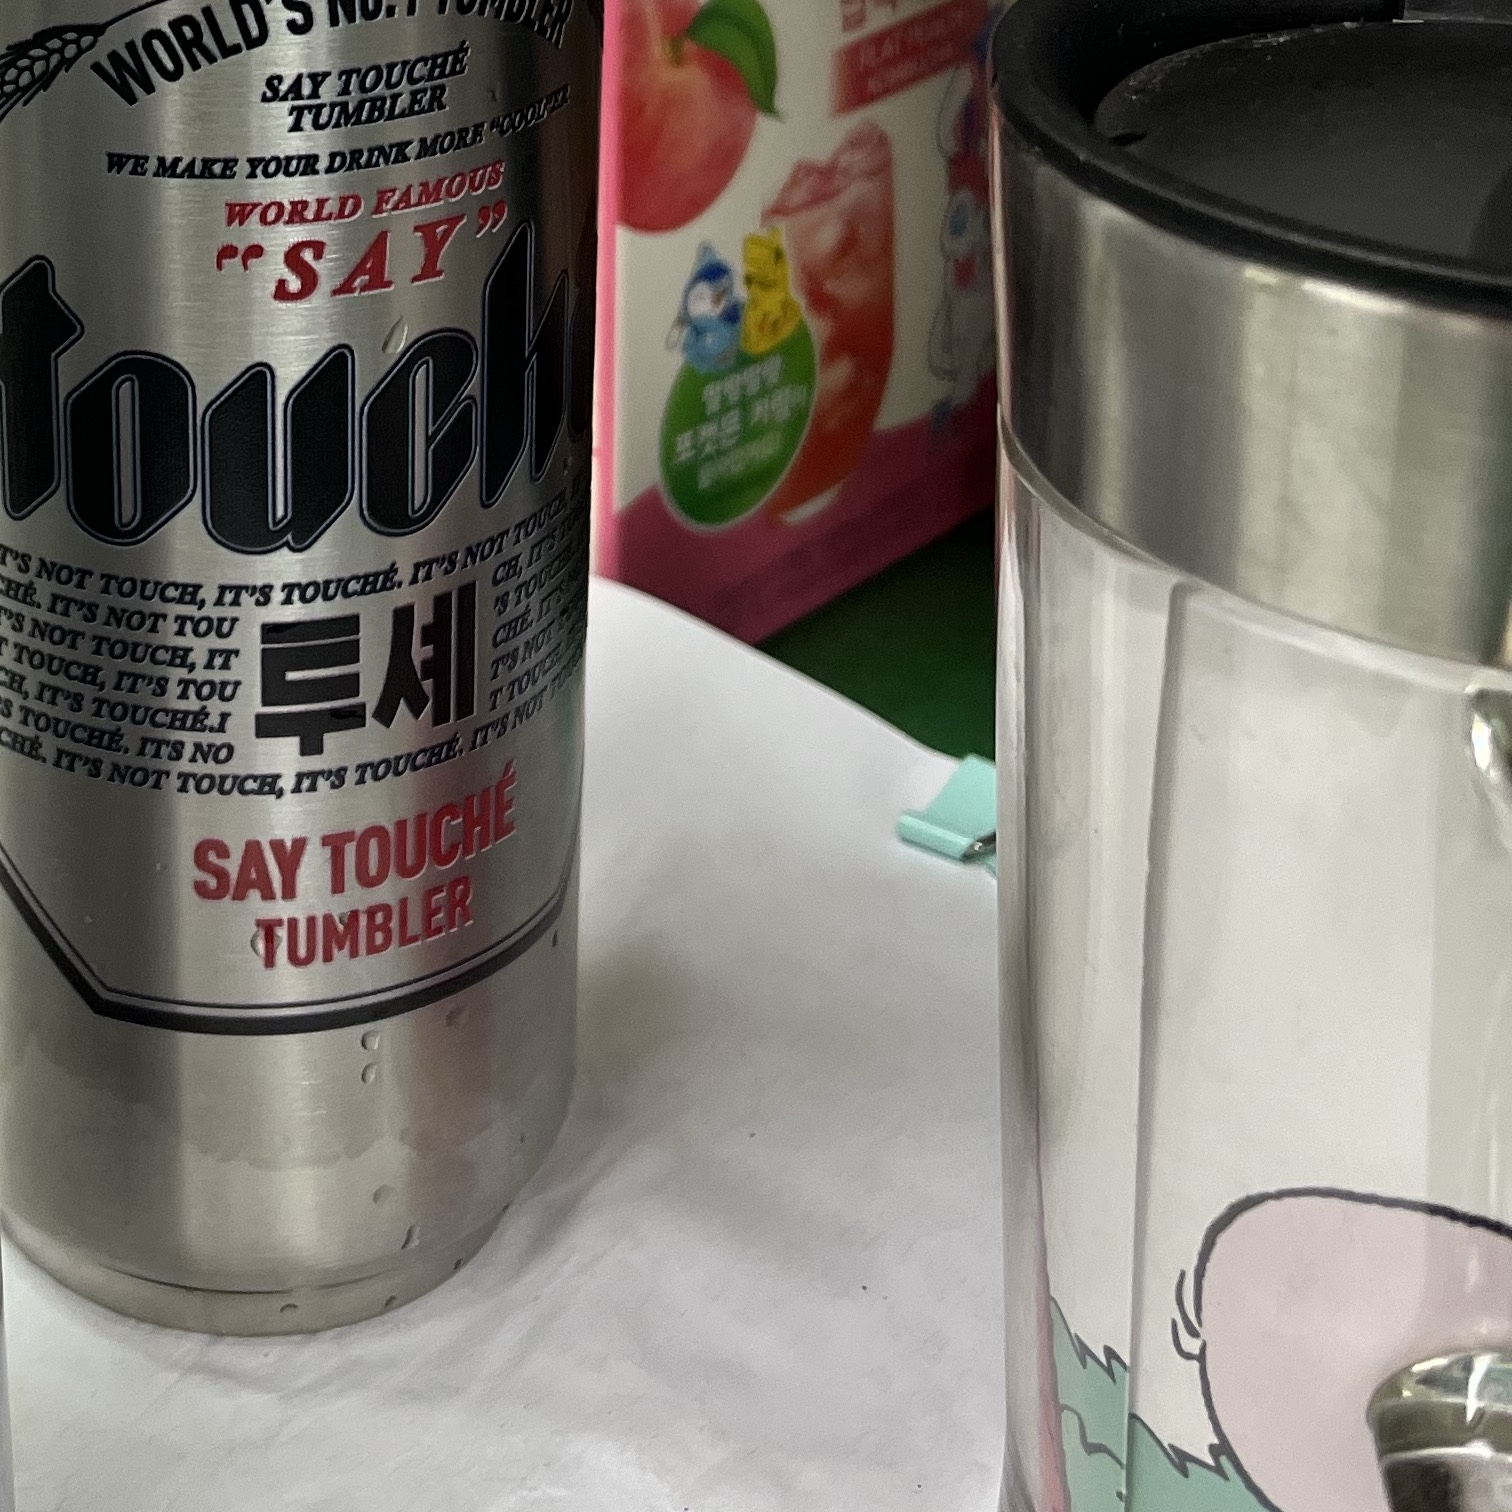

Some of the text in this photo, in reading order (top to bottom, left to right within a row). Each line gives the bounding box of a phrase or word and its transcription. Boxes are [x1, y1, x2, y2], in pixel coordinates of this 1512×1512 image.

[260, 41, 470, 104] SAY TOUCHÉ
[287, 84, 448, 133] TUMBLER
[104, 151, 149, 178] WE
[152, 155, 239, 180] MAKE
[245, 153, 323, 180] YOUR
[326, 141, 413, 176] DRINK
[414, 121, 487, 163] MORE
[225, 160, 507, 229] WORLD FAMOUS
[36, 557, 93, 590] NOT
[100, 573, 206, 611] TOUCH,
[213, 584, 274, 607] IT'S
[281, 561, 403, 605] TOUCHÉ.
[409, 550, 459, 587] IT'S
[462, 529, 511, 570] NOT
[28, 617, 86, 651] NOT
[91, 634, 197, 674] TOUCH,
[203, 648, 240, 671] IT
[47, 592, 99, 624] IT'S
[103, 605, 167, 634] NOT
[174, 614, 240, 638] TOU
[13, 641, 105, 692] TOUCH,
[114, 669, 170, 698] IT'S
[177, 678, 242, 702] TOU
[34, 680, 86, 714] IT'S
[254, 581, 477, 757] 투셰
[489, 688, 504, 713] T
[19, 703, 130, 755] TOUCHÉ.
[189, 741, 235, 765] NO
[52, 746, 103, 779] IT'S
[107, 760, 171, 791] NOT
[177, 771, 285, 800] TOUCH,
[290, 765, 348, 795] IT'S
[354, 731, 465, 786] TOUCHÉ.
[469, 714, 510, 752] IT'S
[511, 687, 549, 730] NOT
[193, 759, 519, 903] SAY TOUCHÉ
[255, 875, 475, 971] TUMBLER
